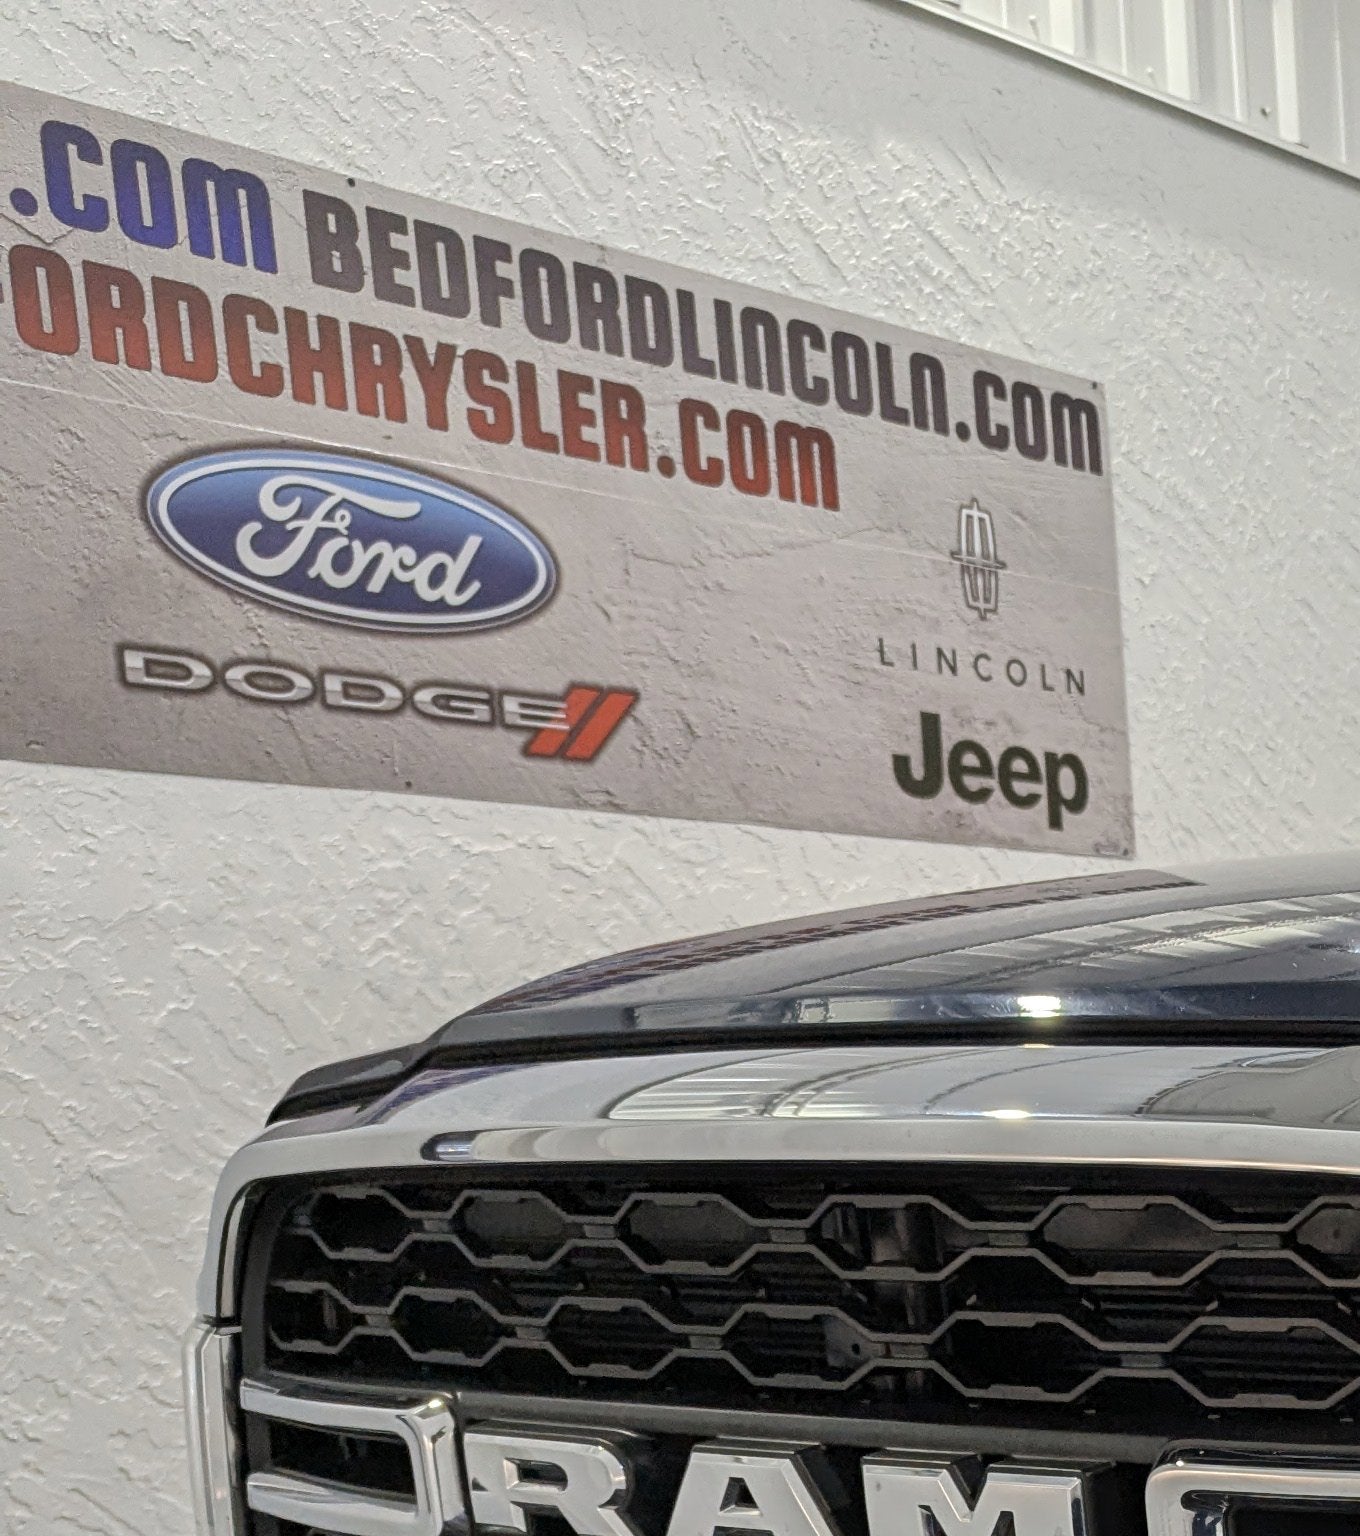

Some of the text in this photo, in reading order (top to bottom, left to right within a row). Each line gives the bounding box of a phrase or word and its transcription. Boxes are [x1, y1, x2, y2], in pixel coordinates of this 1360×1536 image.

[0, 243, 840, 512] ORDCHRYSLER.COM
[302, 188, 1103, 476] BEDFORDLINCOLN.COM
[236, 474, 481, 605] Ford
[122, 648, 570, 732] DODGE
[877, 637, 1085, 696] LINCOLN
[891, 710, 1089, 832] Jeep
